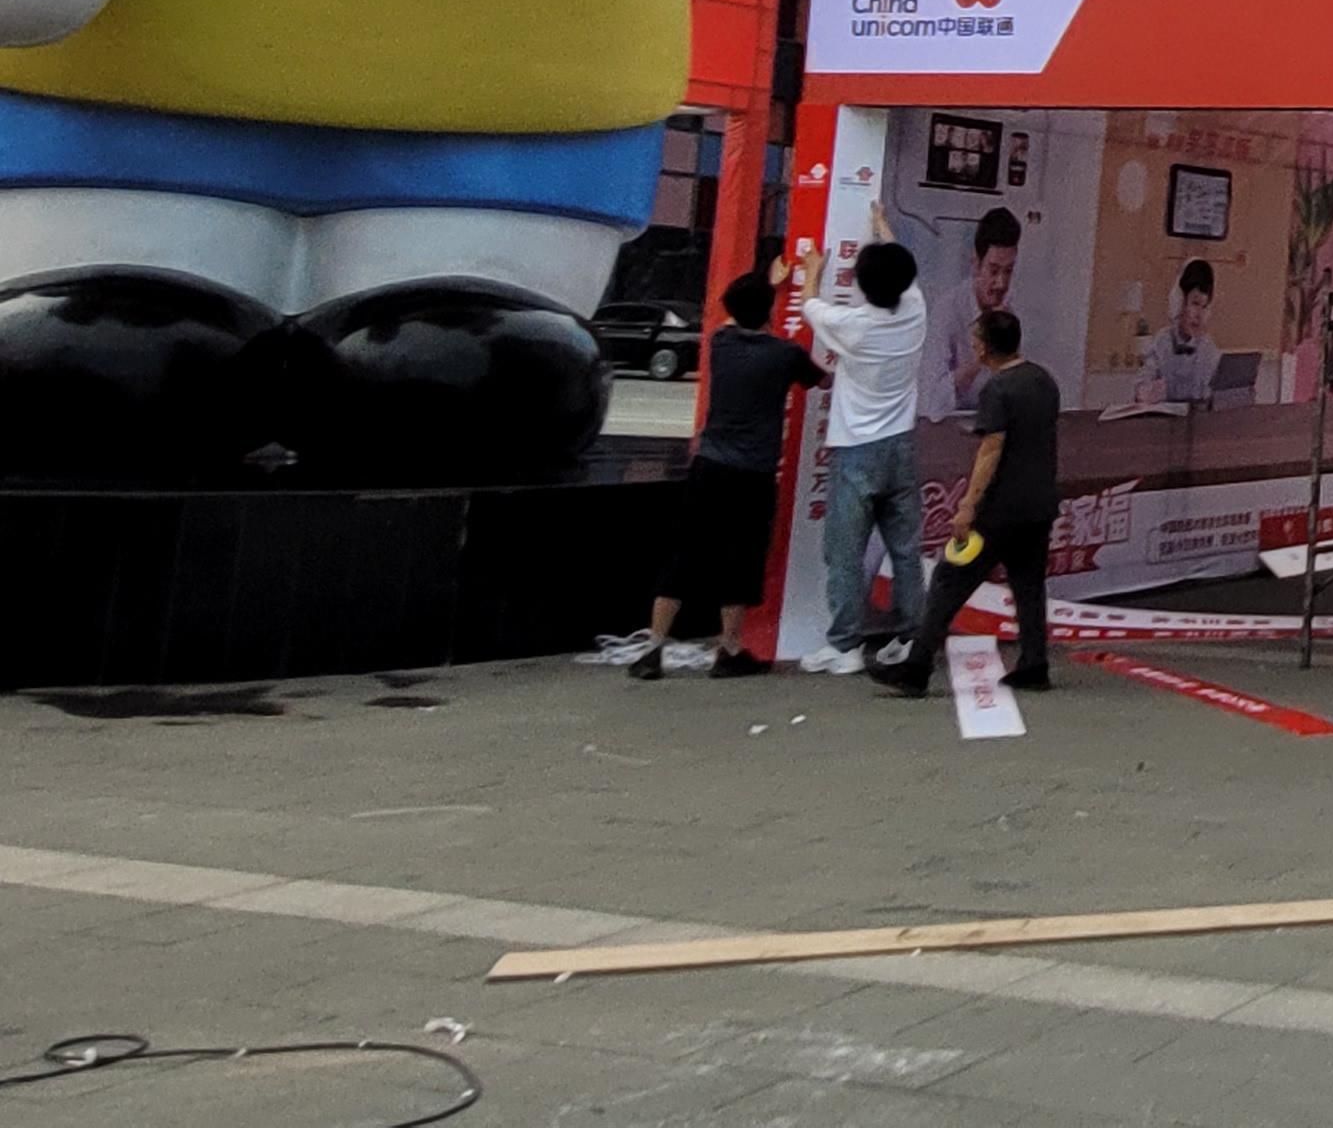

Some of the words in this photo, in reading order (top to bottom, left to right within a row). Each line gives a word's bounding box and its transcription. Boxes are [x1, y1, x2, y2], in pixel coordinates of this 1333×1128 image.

[851, 15, 936, 37] unicom
[937, 16, 1015, 37] 中国联通
